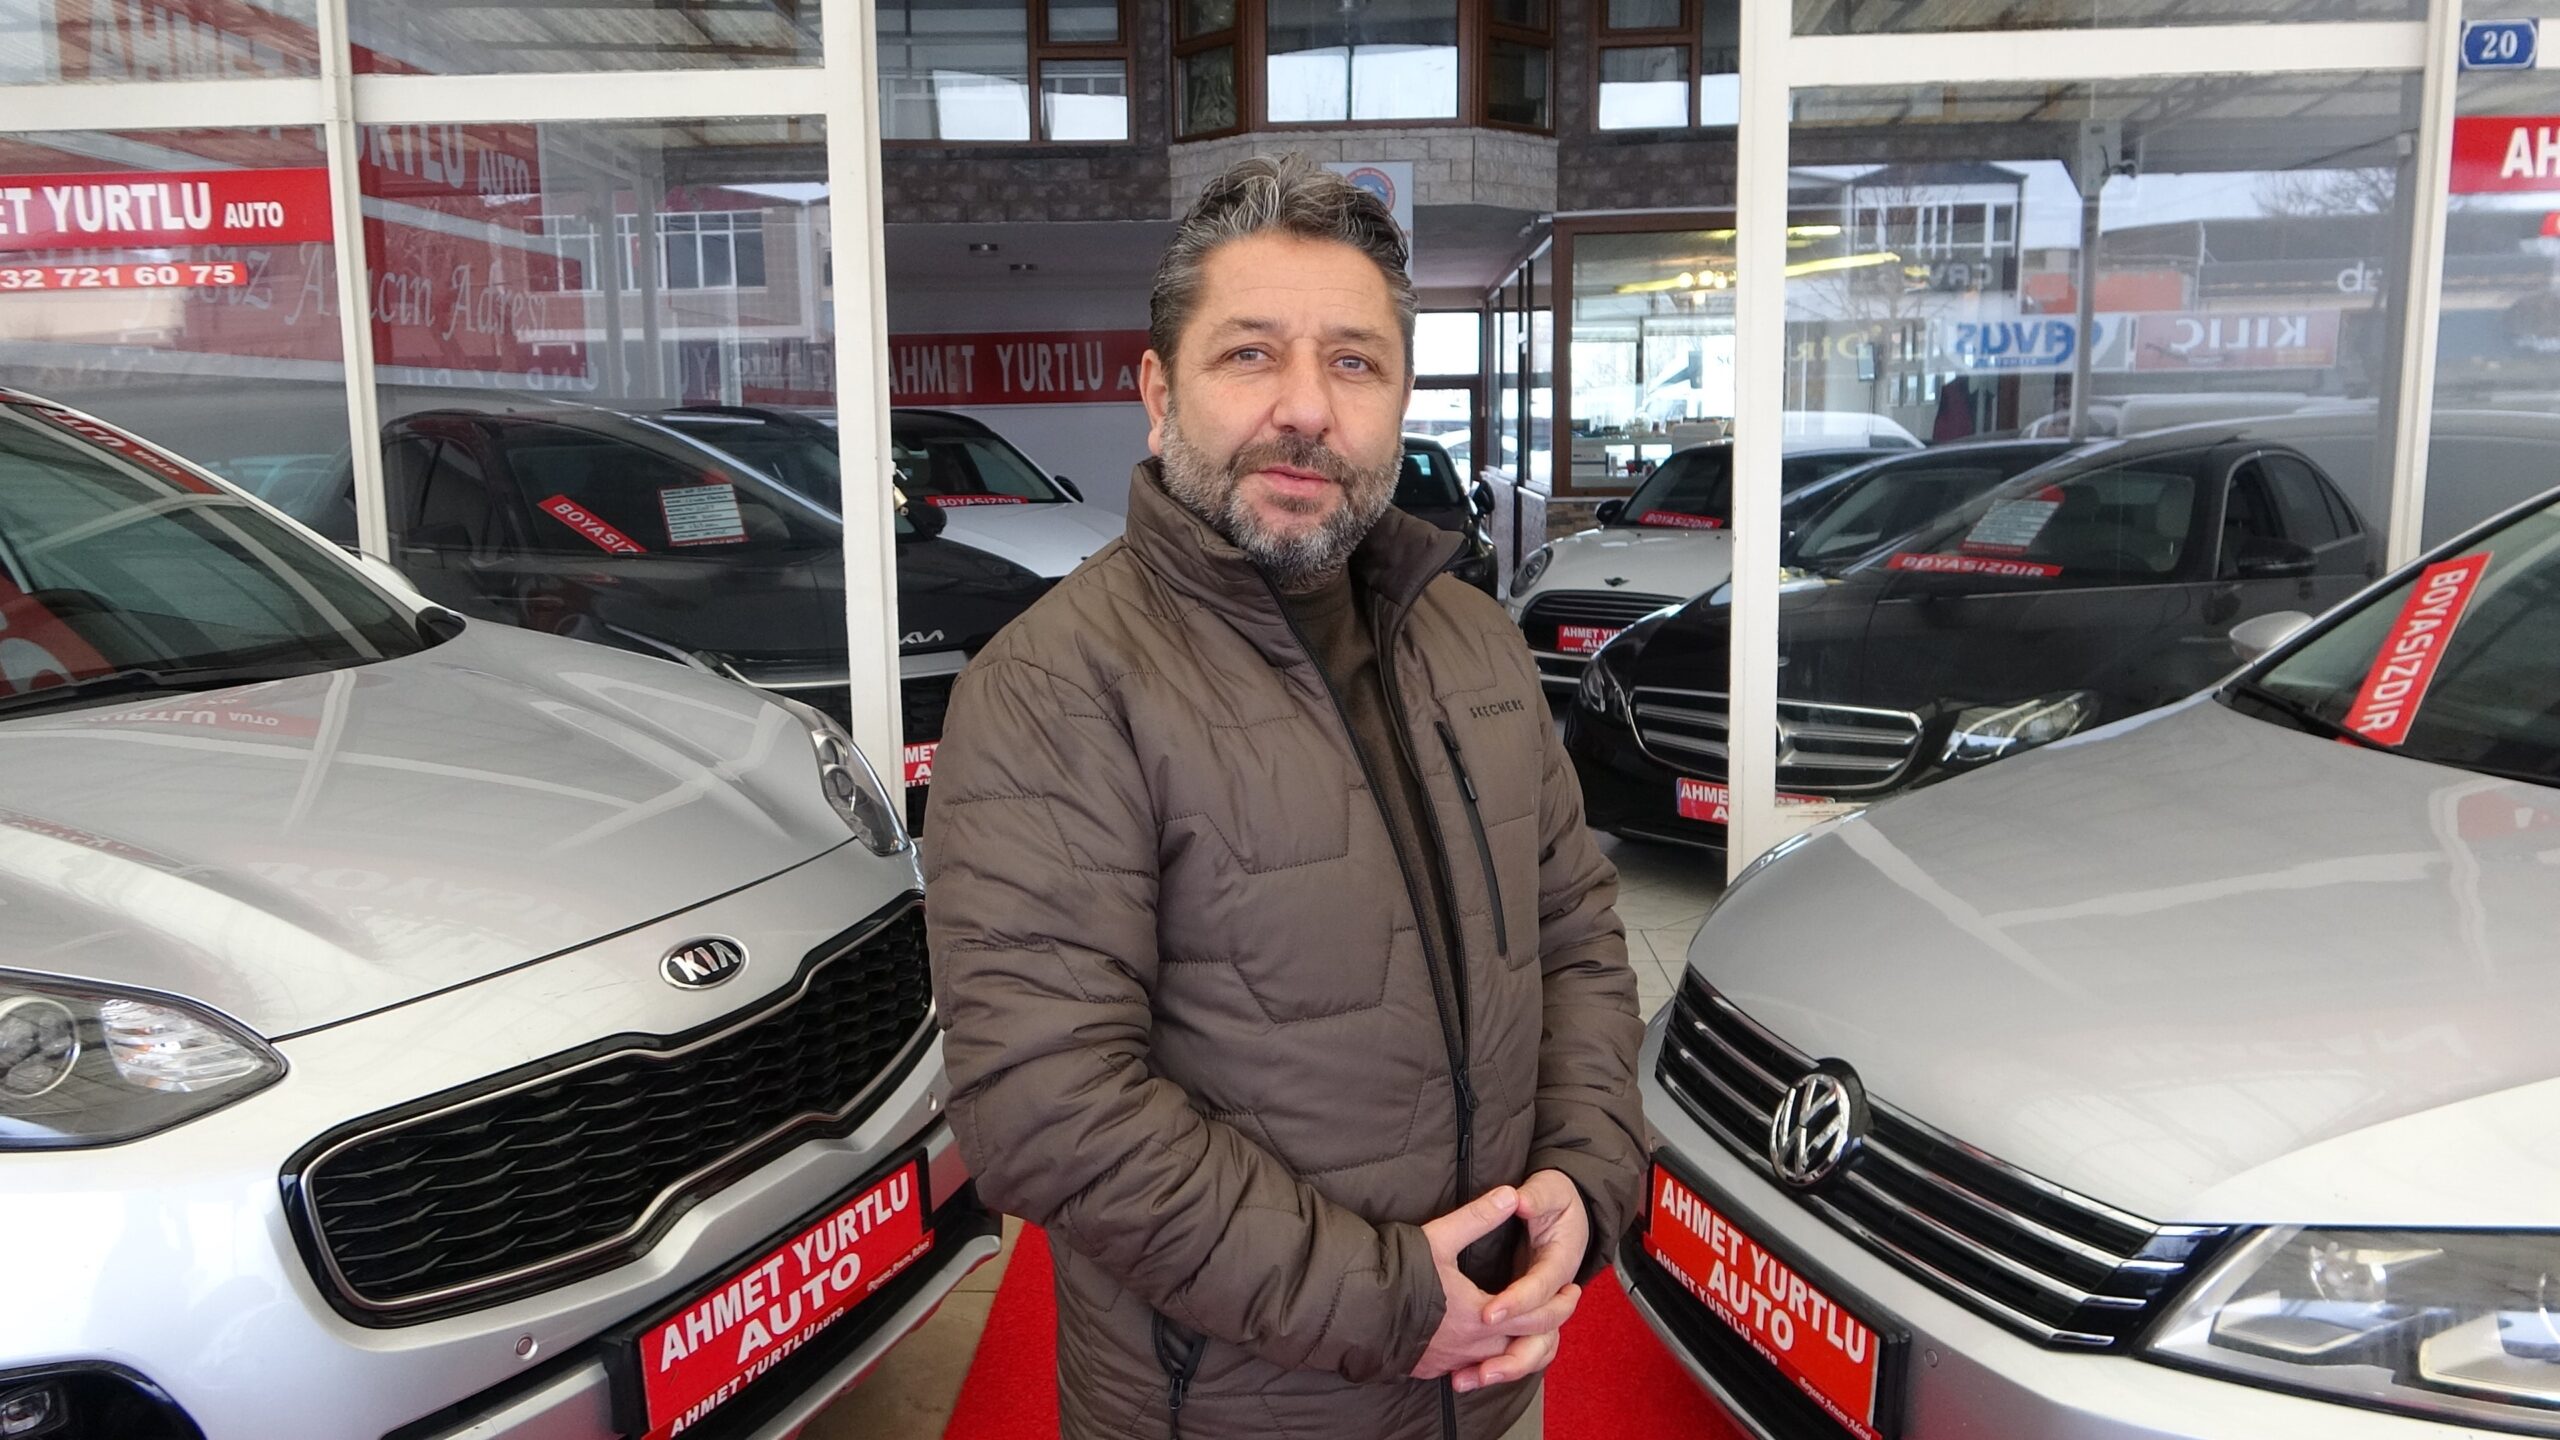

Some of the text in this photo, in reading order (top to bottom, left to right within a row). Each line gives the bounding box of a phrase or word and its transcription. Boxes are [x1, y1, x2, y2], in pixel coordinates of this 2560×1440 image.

[2481, 30, 2518, 59] 20
[44, 182, 212, 233] YURTLU
[224, 202, 284, 229] AUTO
[55, 267, 120, 287] 721
[134, 265, 179, 285] 60
[190, 264, 236, 284] 75
[996, 340, 1105, 392] YURTLU
[1901, 556, 2045, 577] BOYASIZDIR
[1563, 626, 1599, 637] AHMET
[2357, 567, 2469, 733] BOYASIZDIR
[1470, 699, 1525, 719] SKECHERS
[671, 941, 739, 982] KIA
[660, 1171, 910, 1373] AHMET YURTLU
[1660, 1178, 1867, 1364] AHMET YURTLU
[737, 1254, 861, 1364] AUTO
[1656, 1248, 1778, 1366] AHMET YURTLU AUTO
[1708, 1259, 1794, 1352] AUTO
[670, 1306, 844, 1438] AHMET YURTLU AUTO
